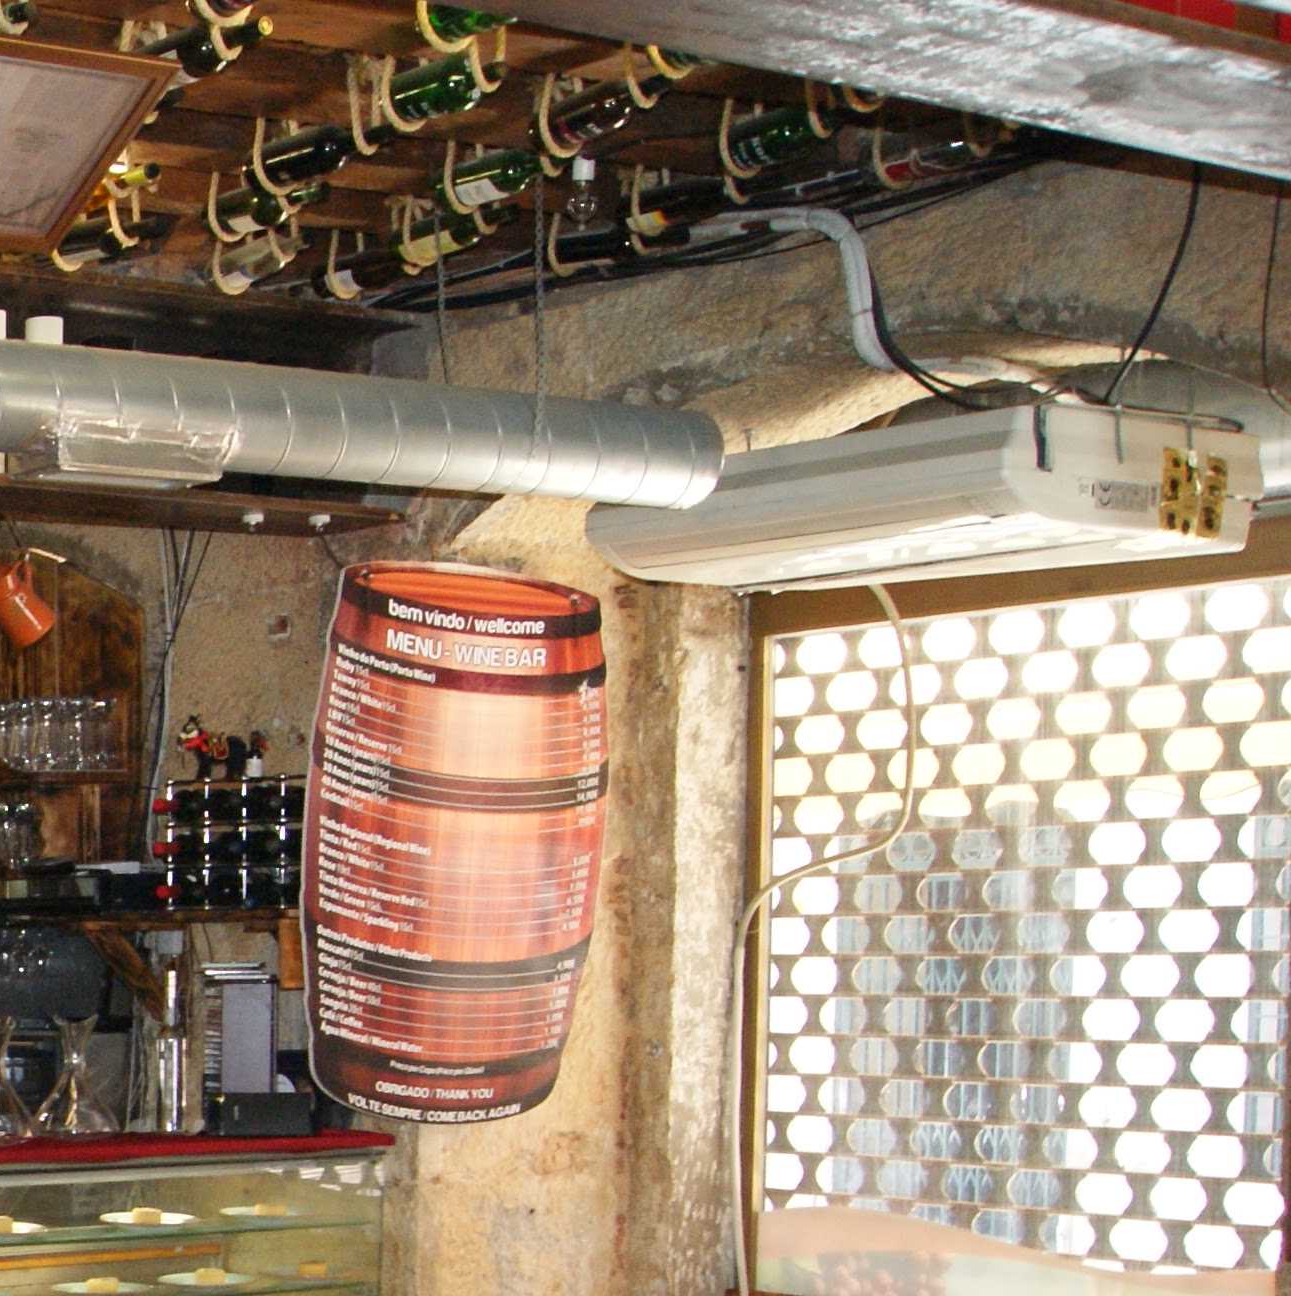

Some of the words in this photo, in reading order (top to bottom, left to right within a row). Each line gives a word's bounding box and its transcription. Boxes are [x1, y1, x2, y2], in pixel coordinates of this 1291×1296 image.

[389, 598, 423, 622] bem
[425, 609, 465, 630] vindo
[474, 617, 546, 635] wellcome
[386, 629, 443, 659] MENU
[454, 643, 504, 667] WINE
[505, 647, 547, 668] BAR
[375, 1081, 429, 1098] OBRIGADO
[435, 1088, 469, 1099] THANK
[471, 1088, 494, 1099] YOU
[348, 1092, 381, 1114] VOLTE
[381, 1101, 422, 1120] SEMPRE
[427, 1110, 457, 1122] COME
[457, 1107, 487, 1121] BACK
[486, 1104, 522, 1118] AGAIN
